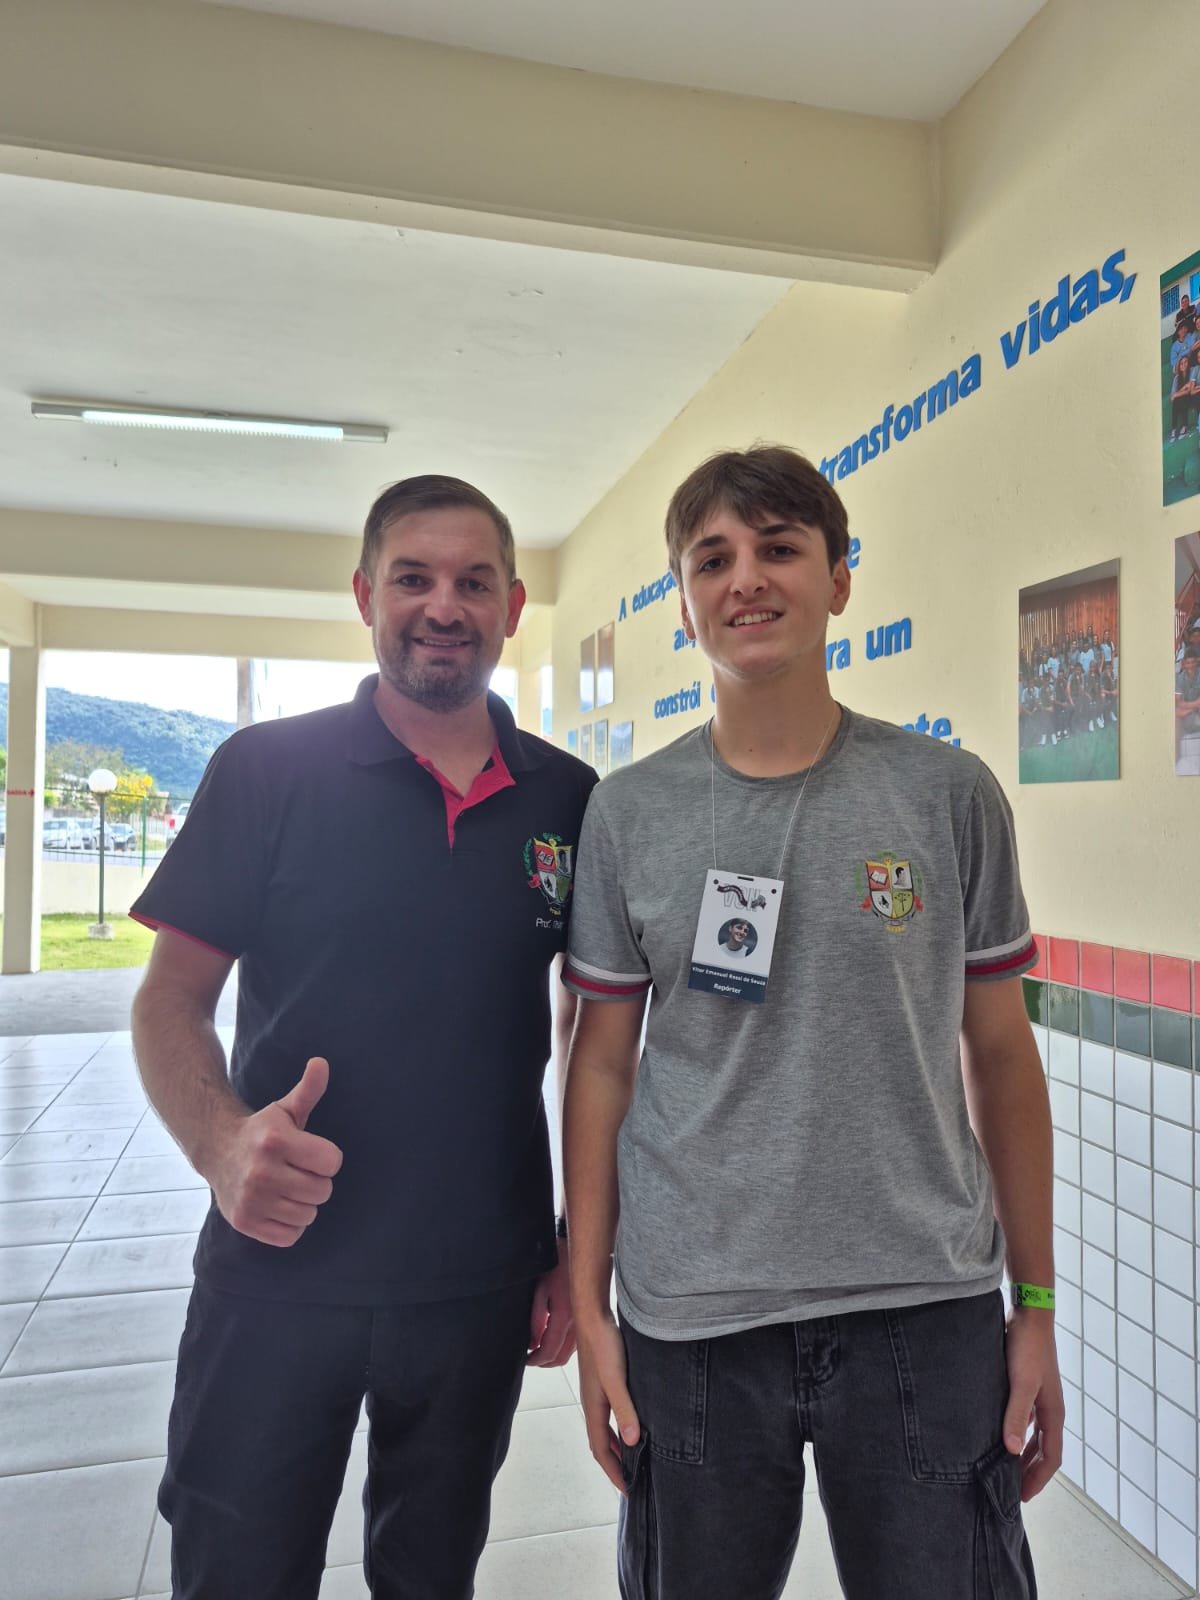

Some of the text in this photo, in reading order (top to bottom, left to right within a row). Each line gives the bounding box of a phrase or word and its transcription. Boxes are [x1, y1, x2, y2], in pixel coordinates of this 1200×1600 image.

[618, 596, 627, 622] A
[819, 353, 982, 487] transforma
[1000, 248, 1138, 370] vidas,
[654, 679, 701, 719] constrói
[866, 616, 912, 660] um
[713, 982, 743, 994] Repórter
